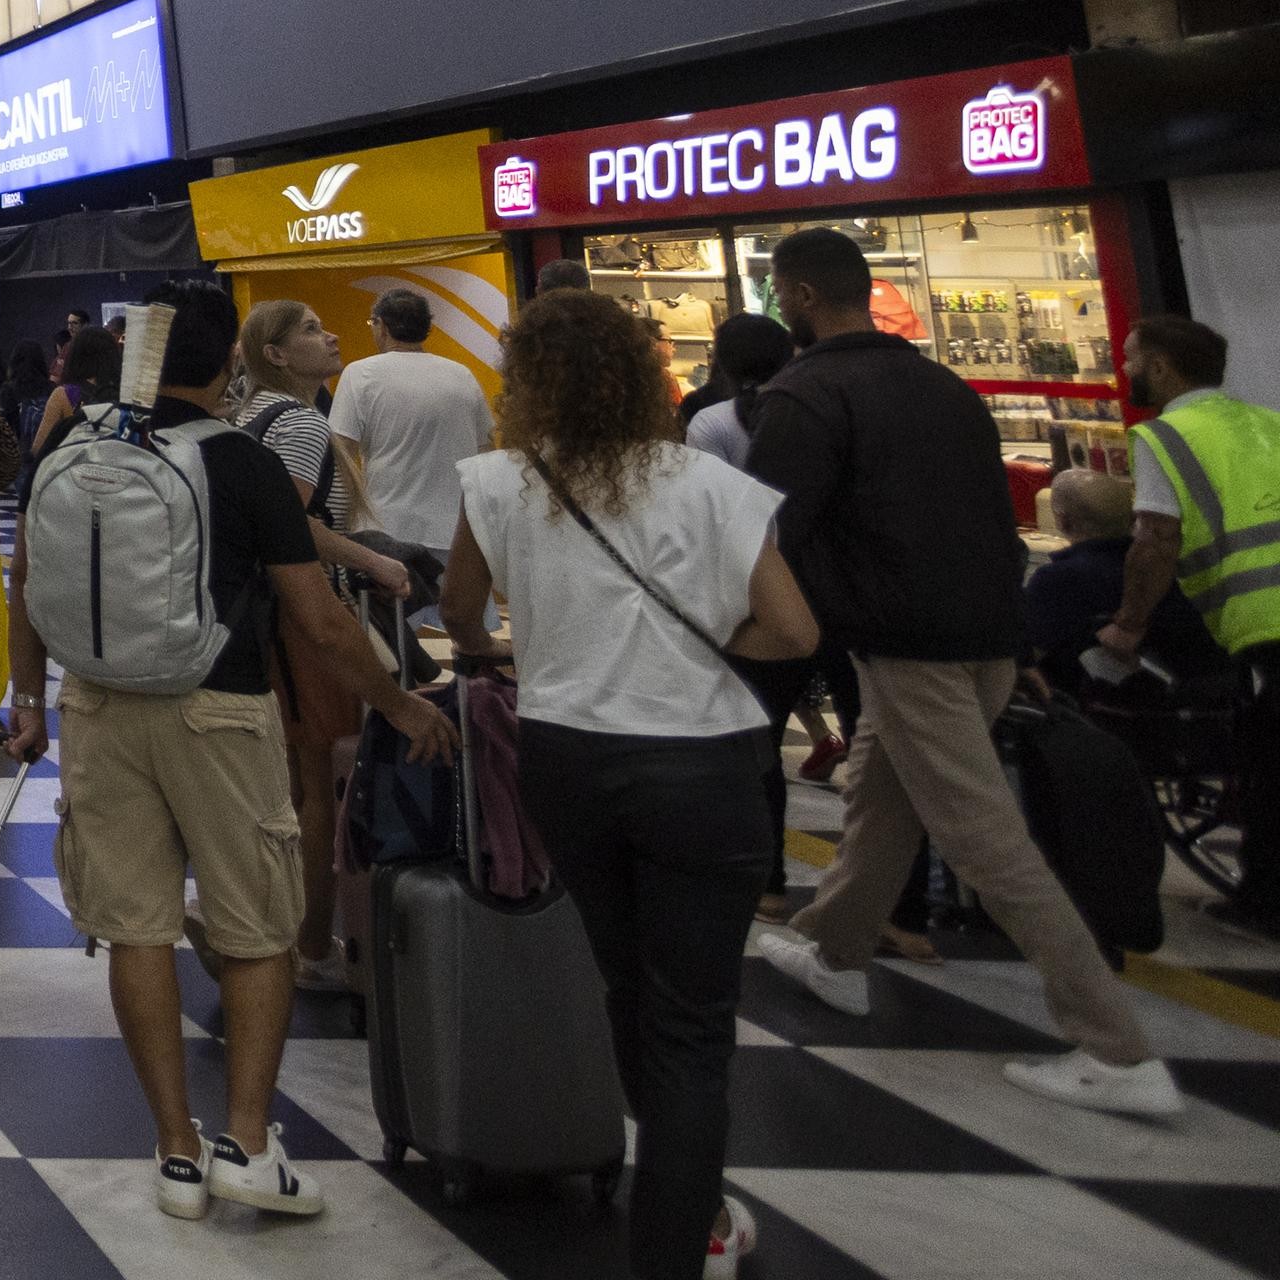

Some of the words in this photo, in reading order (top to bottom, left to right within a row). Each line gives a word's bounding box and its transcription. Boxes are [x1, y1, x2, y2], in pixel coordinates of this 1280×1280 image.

[970, 106, 1032, 129] PROTEC
[971, 124, 1034, 160] BAG
[589, 130, 763, 205] PROTEC
[775, 107, 896, 188] BAG
[499, 170, 530, 185] PROTEC
[499, 183, 530, 208] BAG
[287, 211, 362, 243] VOEPASS
[169, 1164, 190, 1175] VERT
